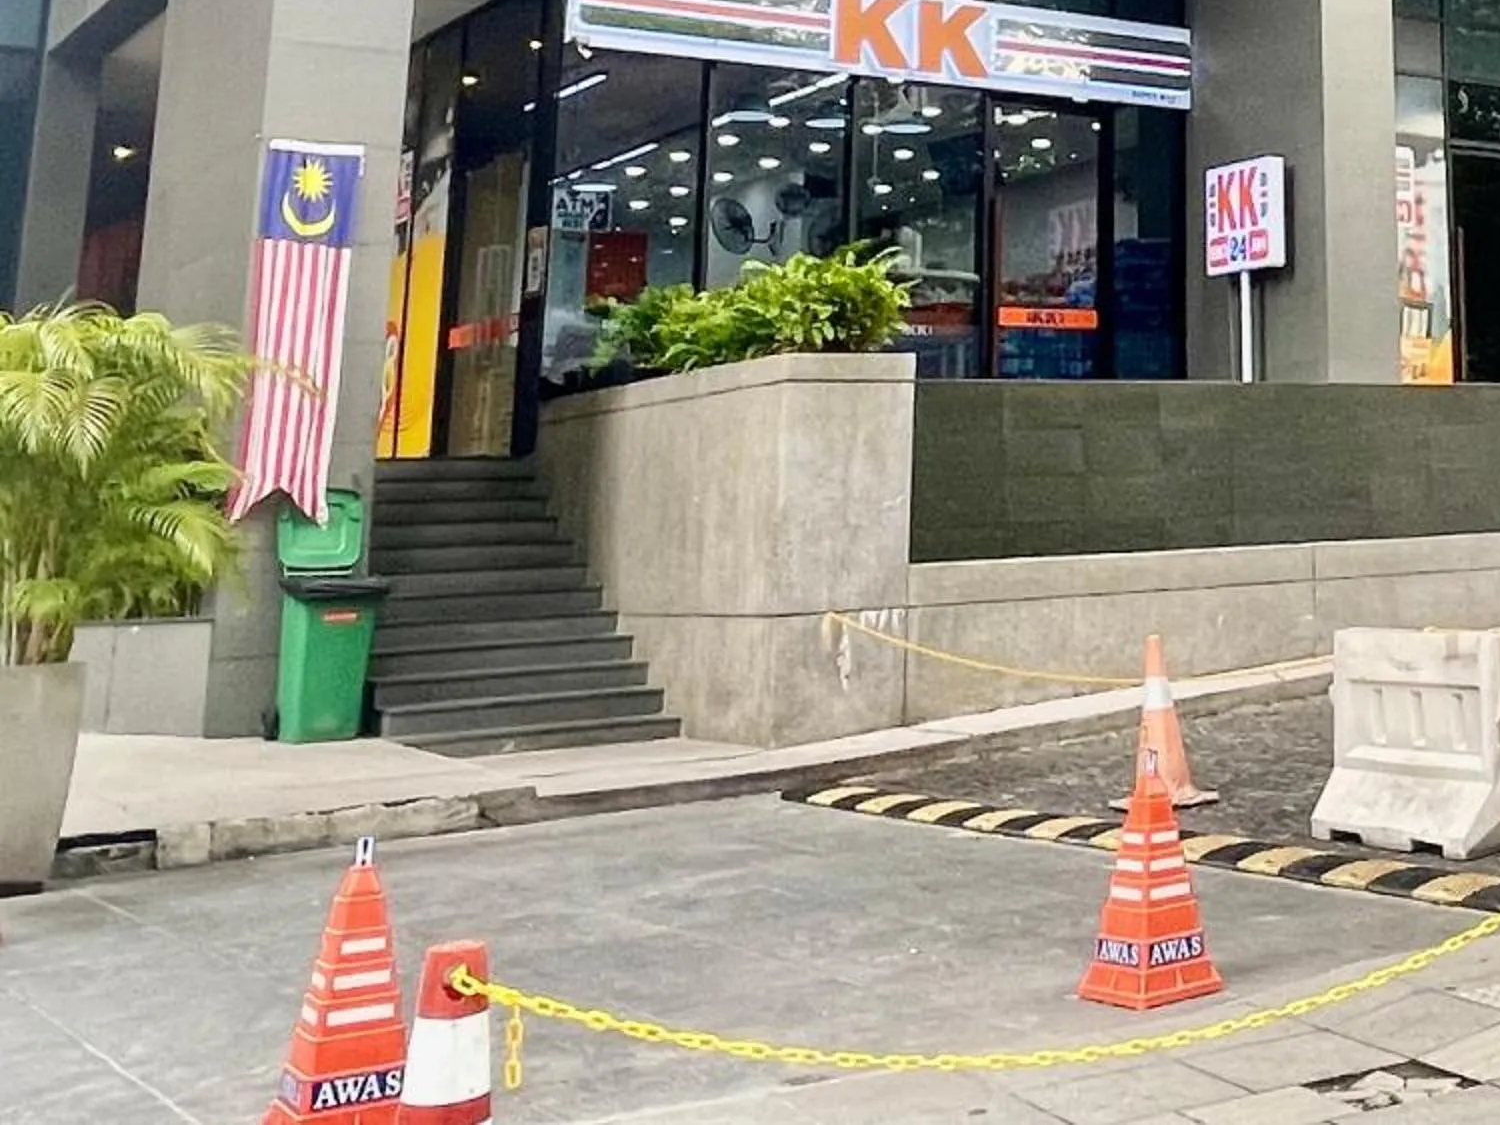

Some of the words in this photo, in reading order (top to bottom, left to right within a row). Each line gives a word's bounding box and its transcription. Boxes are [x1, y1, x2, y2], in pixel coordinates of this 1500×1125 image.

[1217, 166, 1259, 233] KK
[1099, 939, 1139, 965] AWAS
[1150, 936, 1202, 965] AWAS
[313, 1069, 401, 1109] AWAS
